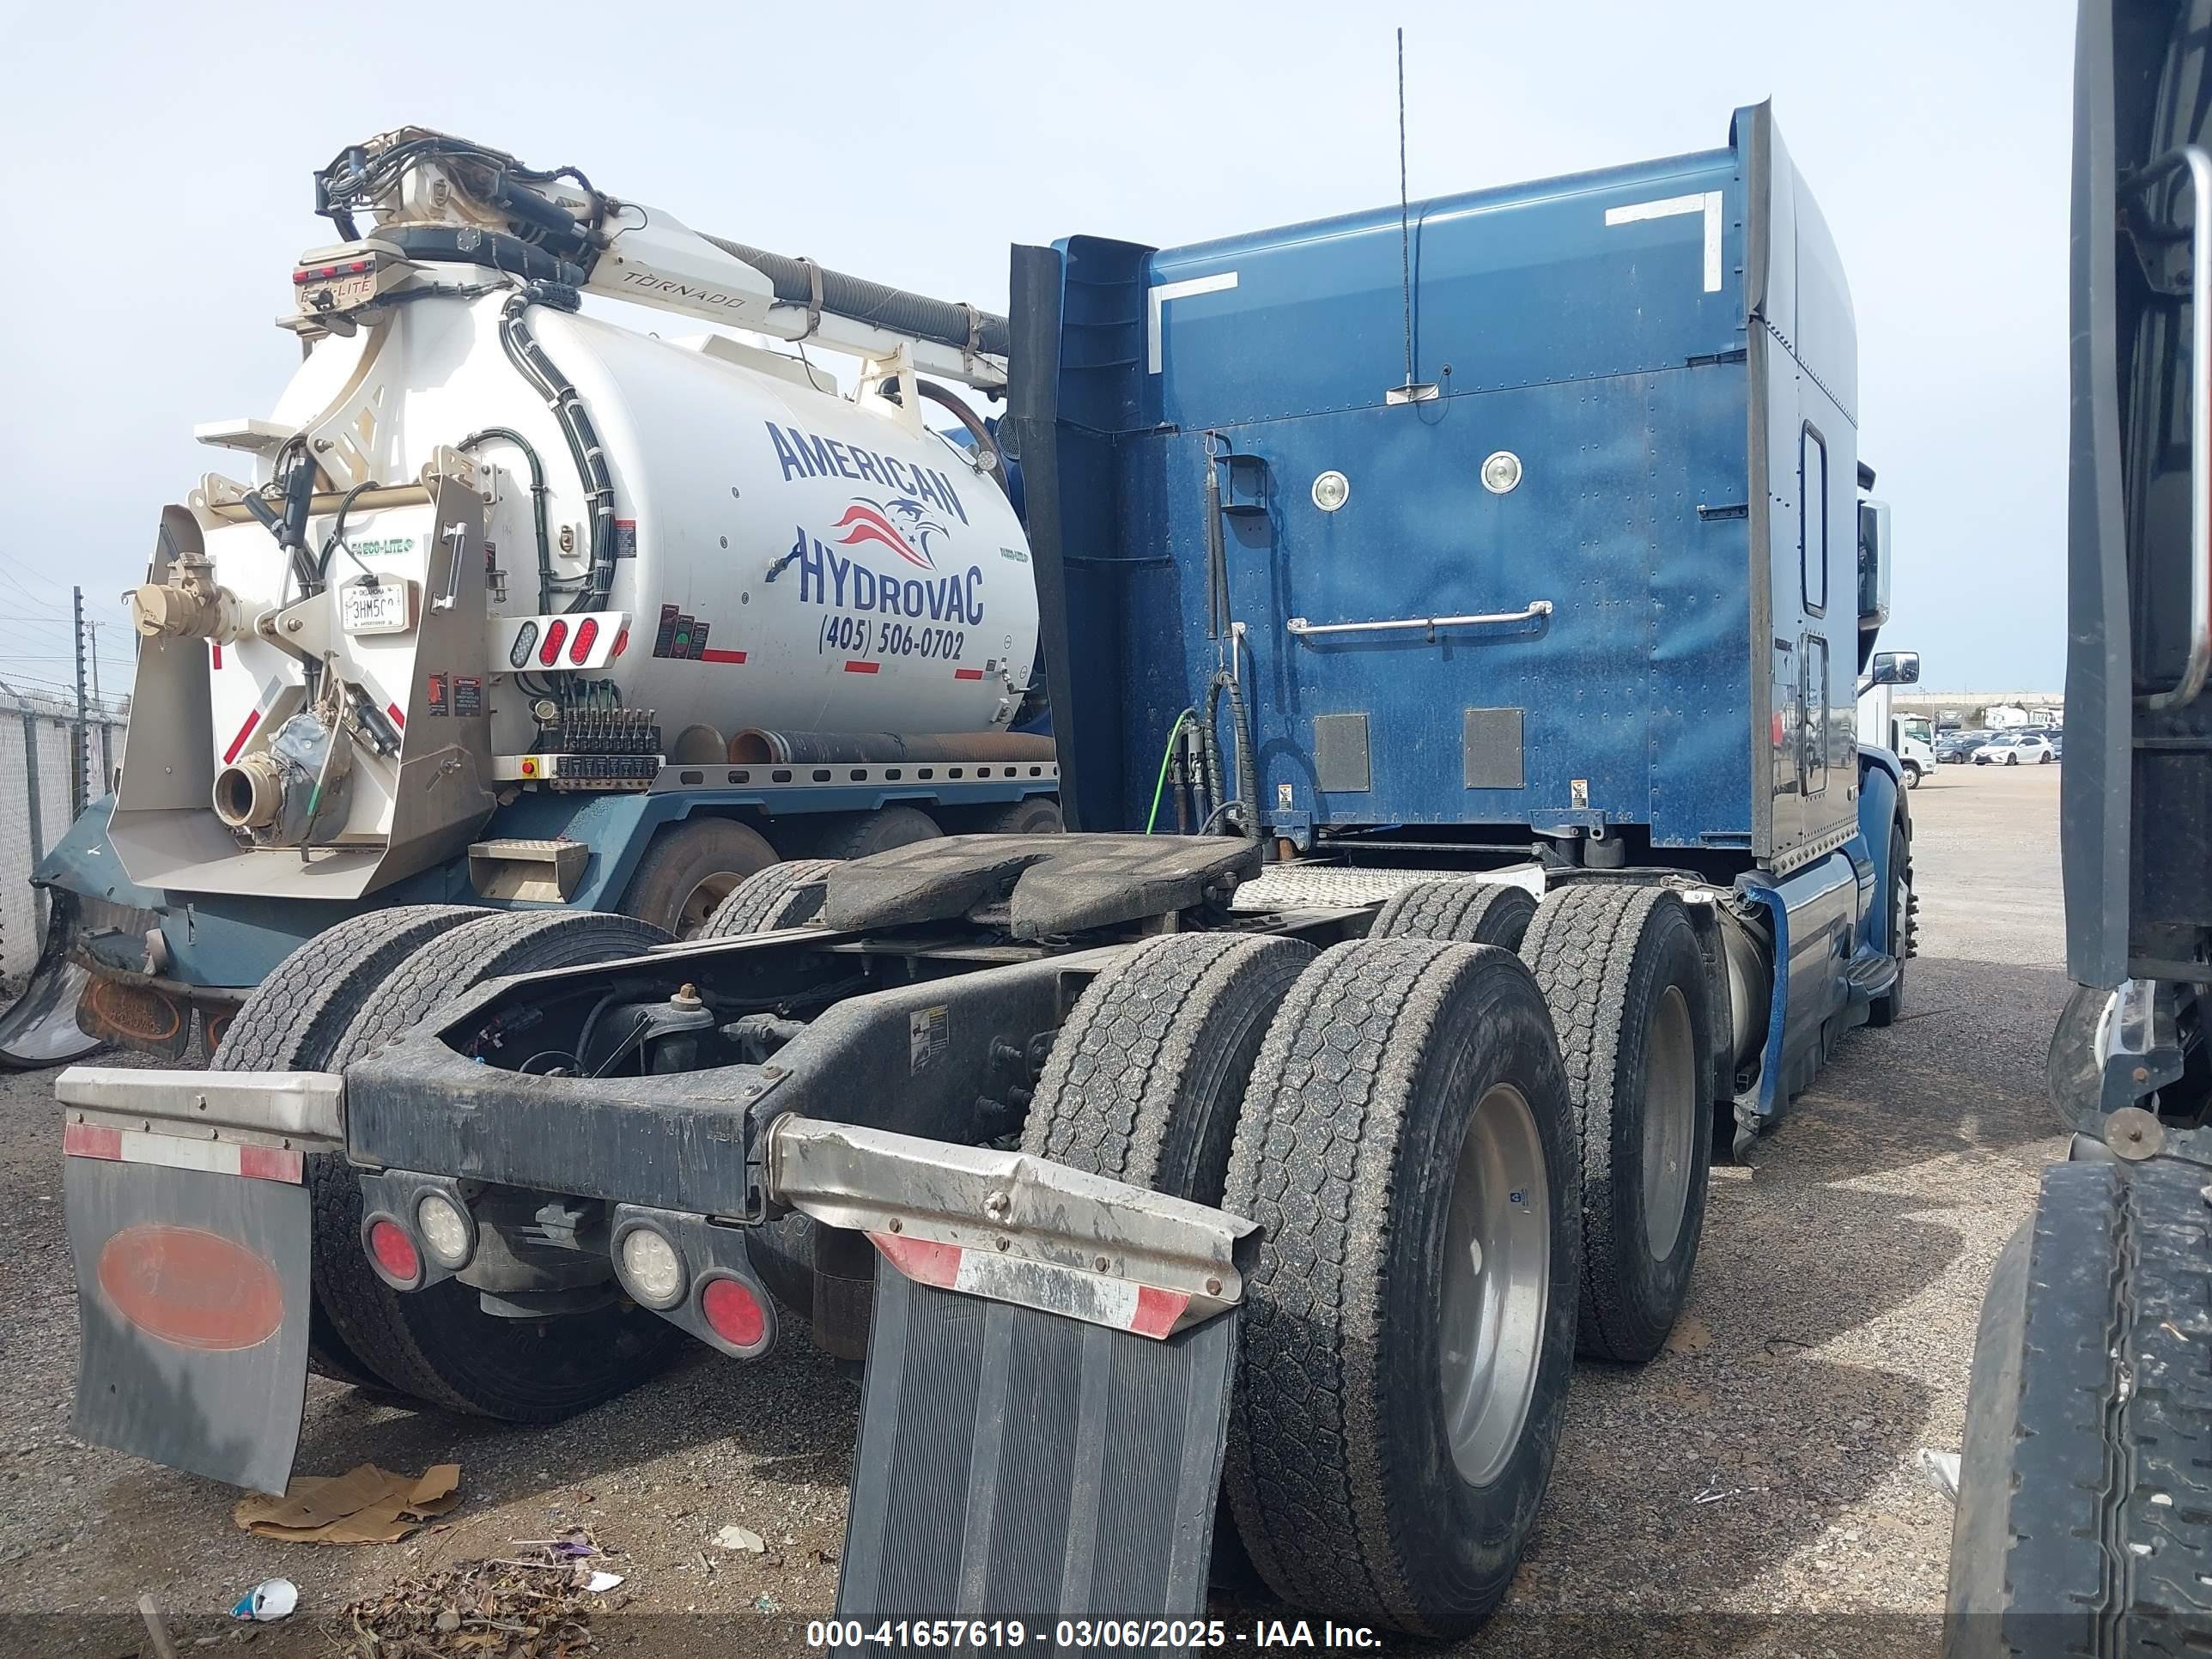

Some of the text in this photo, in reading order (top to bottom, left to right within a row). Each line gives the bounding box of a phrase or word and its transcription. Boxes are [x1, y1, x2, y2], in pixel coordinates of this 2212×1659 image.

[623, 271, 746, 308] TORNADO
[764, 420, 969, 527] AMERICAN
[359, 587, 385, 597] OKLAHOMA
[796, 525, 984, 625] HYDROVAC
[818, 614, 964, 660] (405) 506-0702
